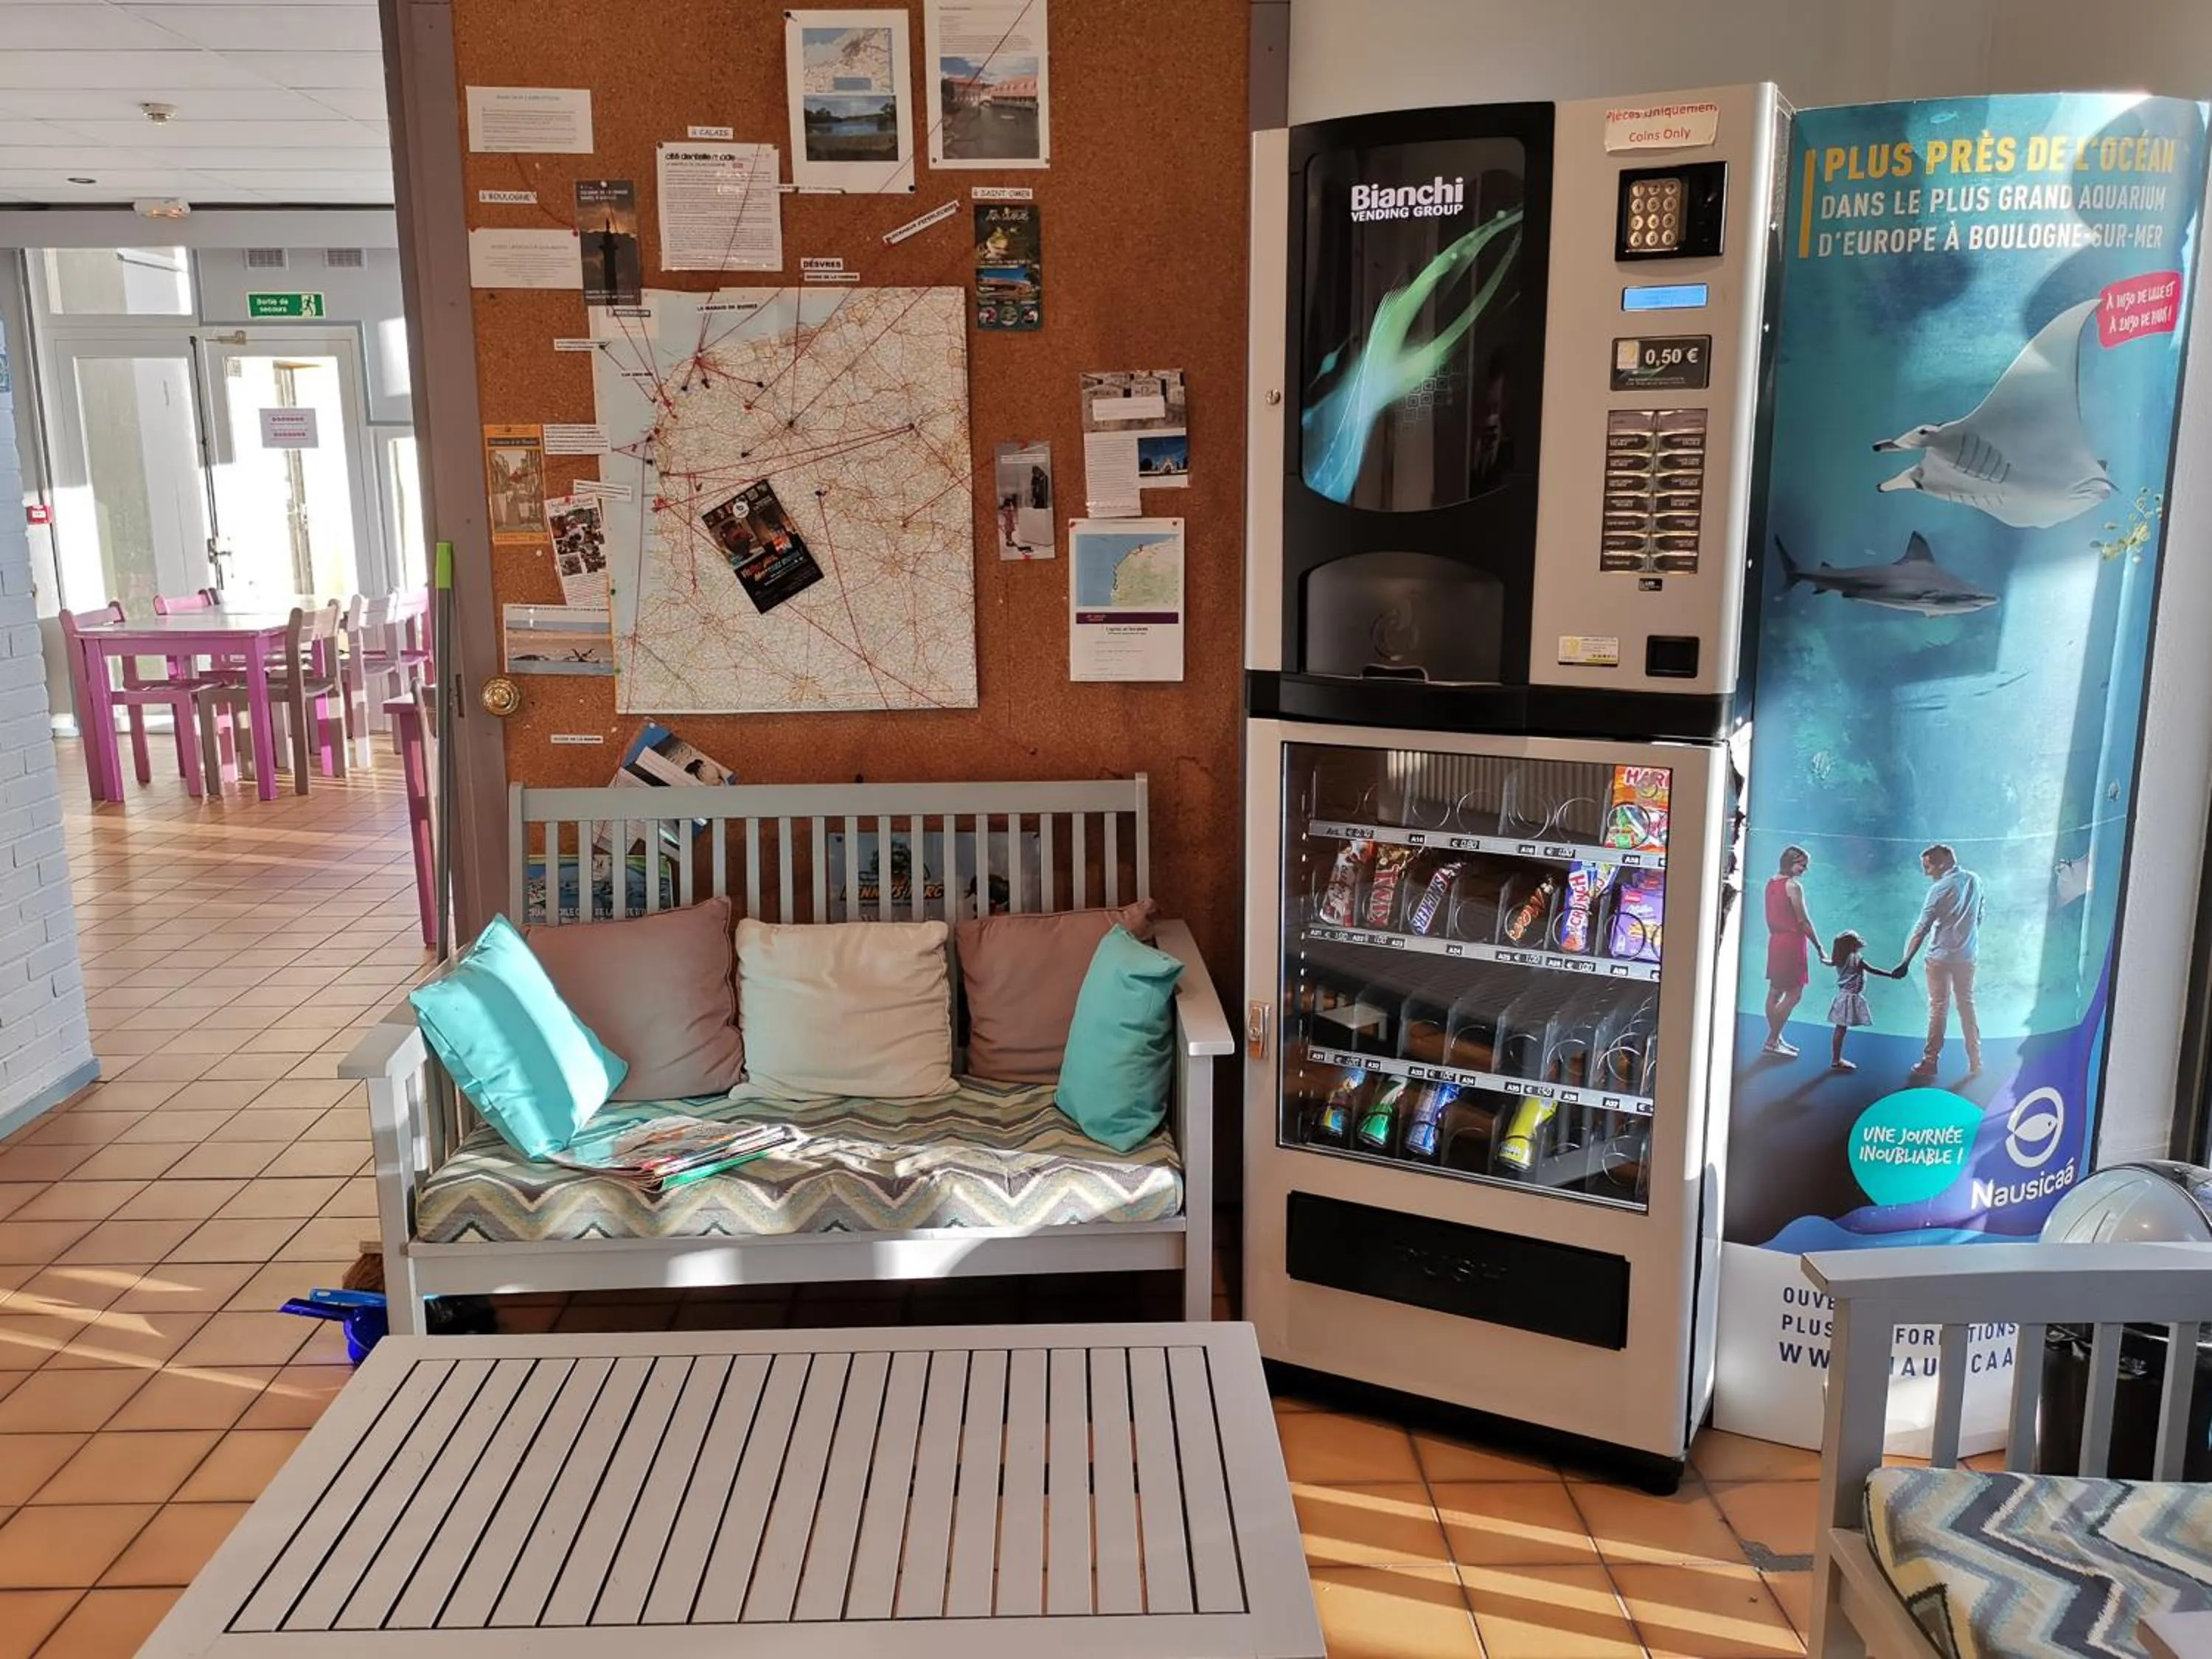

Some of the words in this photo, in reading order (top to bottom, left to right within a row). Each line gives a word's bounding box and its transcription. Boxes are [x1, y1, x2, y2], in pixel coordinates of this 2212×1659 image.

[1629, 130, 1660, 142] Coins
[1663, 126, 1691, 140] Only
[1824, 142, 1913, 182] PLUS
[1925, 129, 2017, 175] PRÈS
[2027, 136, 2067, 171] DE
[2075, 129, 2176, 173] L'OCÉAN
[1351, 175, 1464, 212] Bianchi
[1820, 191, 1885, 220] DANS
[1893, 189, 1921, 215] LE
[1929, 186, 1992, 213] PLUS
[1997, 184, 2073, 211] GRAND
[2078, 184, 2167, 212] AQUARIUM
[1351, 208, 1409, 222] VENDING
[1413, 204, 1464, 219] GROUP
[1818, 227, 1937, 257] D'EUROPE
[1943, 220, 1960, 251] À
[1968, 223, 2164, 251] BOULOGNE-SUR-MER
[256, 297, 278, 306] Sortie
[279, 297, 289, 306] de
[1645, 348, 1682, 367] 0,50
[1686, 347, 1700, 364] €
[1413, 874, 1447, 933] SNICKERS
[1568, 873, 1588, 931] CRUNCH
[1863, 1126, 1897, 1143] UNE
[1897, 1124, 1965, 1145] JOURNÉE
[1859, 1144, 1953, 1166] INOUBLIABLE
[1781, 1313, 1834, 1338] PLUS
